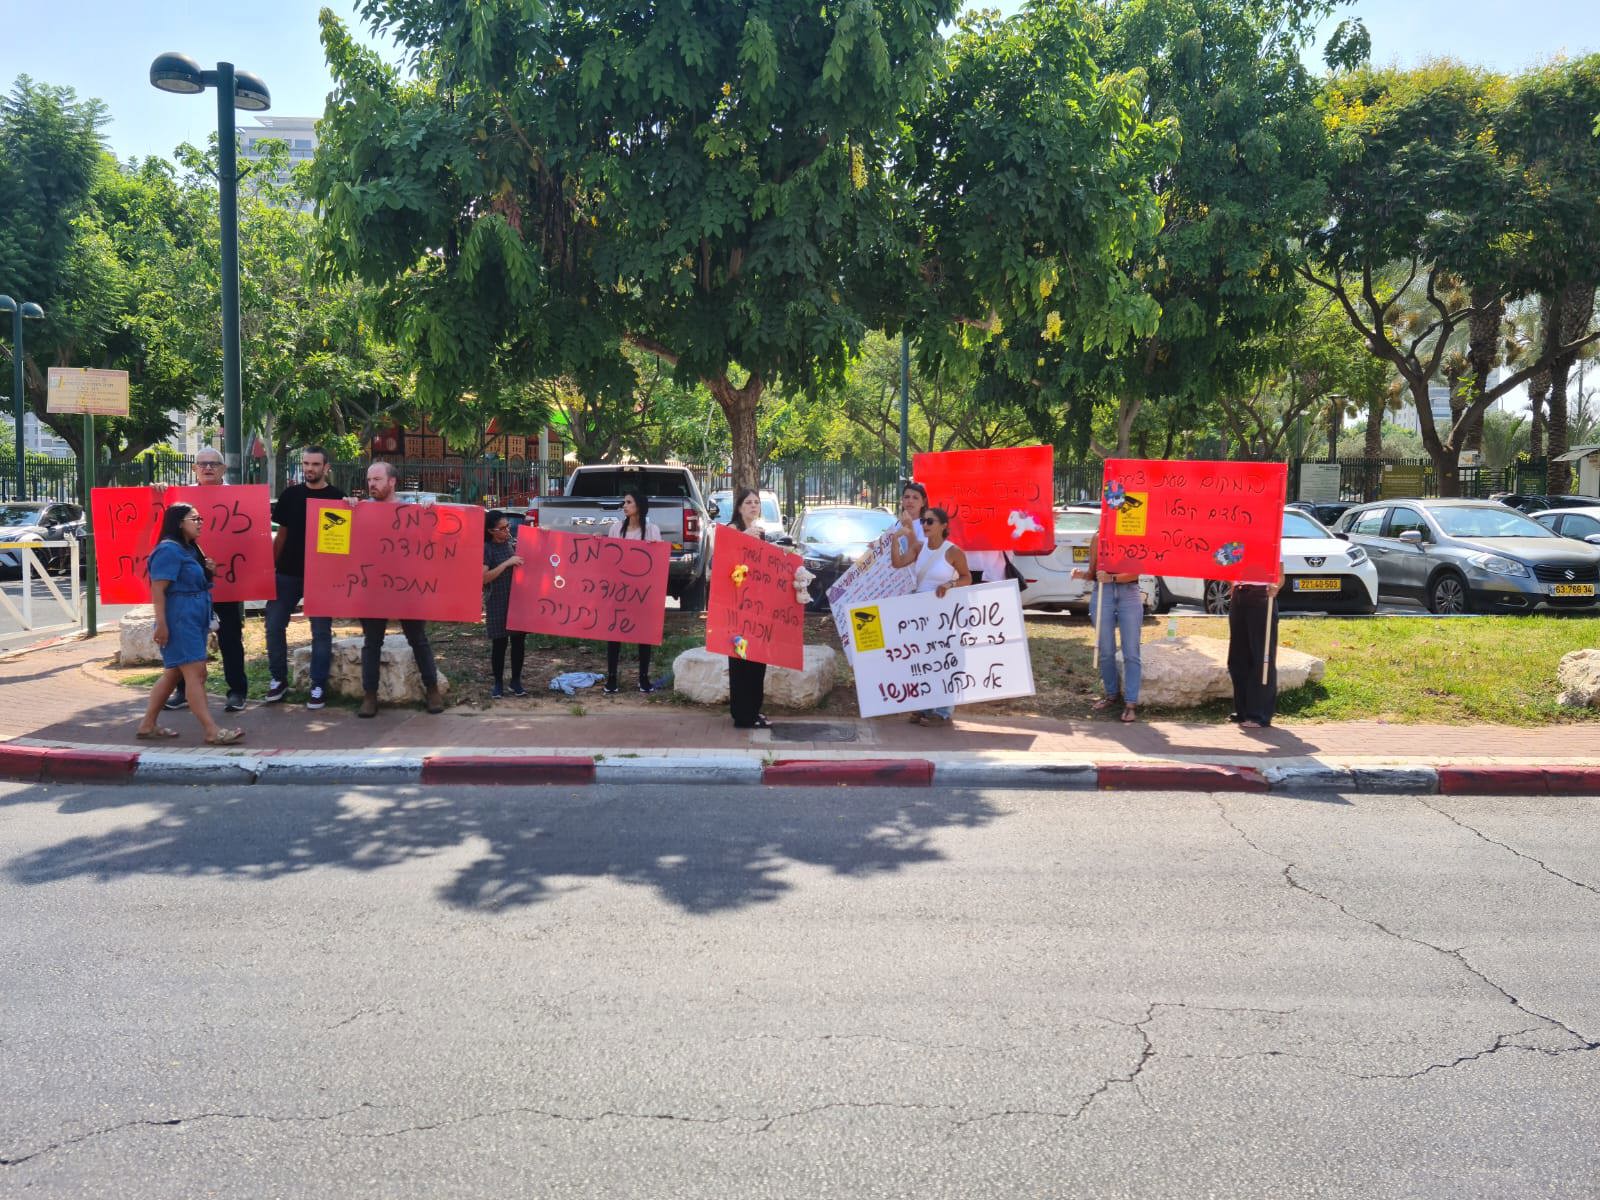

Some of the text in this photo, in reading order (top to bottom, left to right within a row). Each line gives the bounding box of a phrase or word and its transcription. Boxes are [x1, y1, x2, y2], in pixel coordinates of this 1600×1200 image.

[107, 503, 137, 540] בגן
[209, 500, 253, 534] זה
[391, 504, 462, 535] כרמל
[379, 537, 458, 560] מעודה
[569, 537, 653, 577] כרמל
[380, 573, 439, 594] מחכה
[581, 578, 652, 604] מעודה
[537, 598, 636, 634] של נתניה
[898, 616, 929, 635] יקרים
[987, 631, 1006, 645] זה
[885, 643, 920, 662] הנכד
[942, 671, 975, 694] תקלו
[983, 663, 1004, 689] אל
